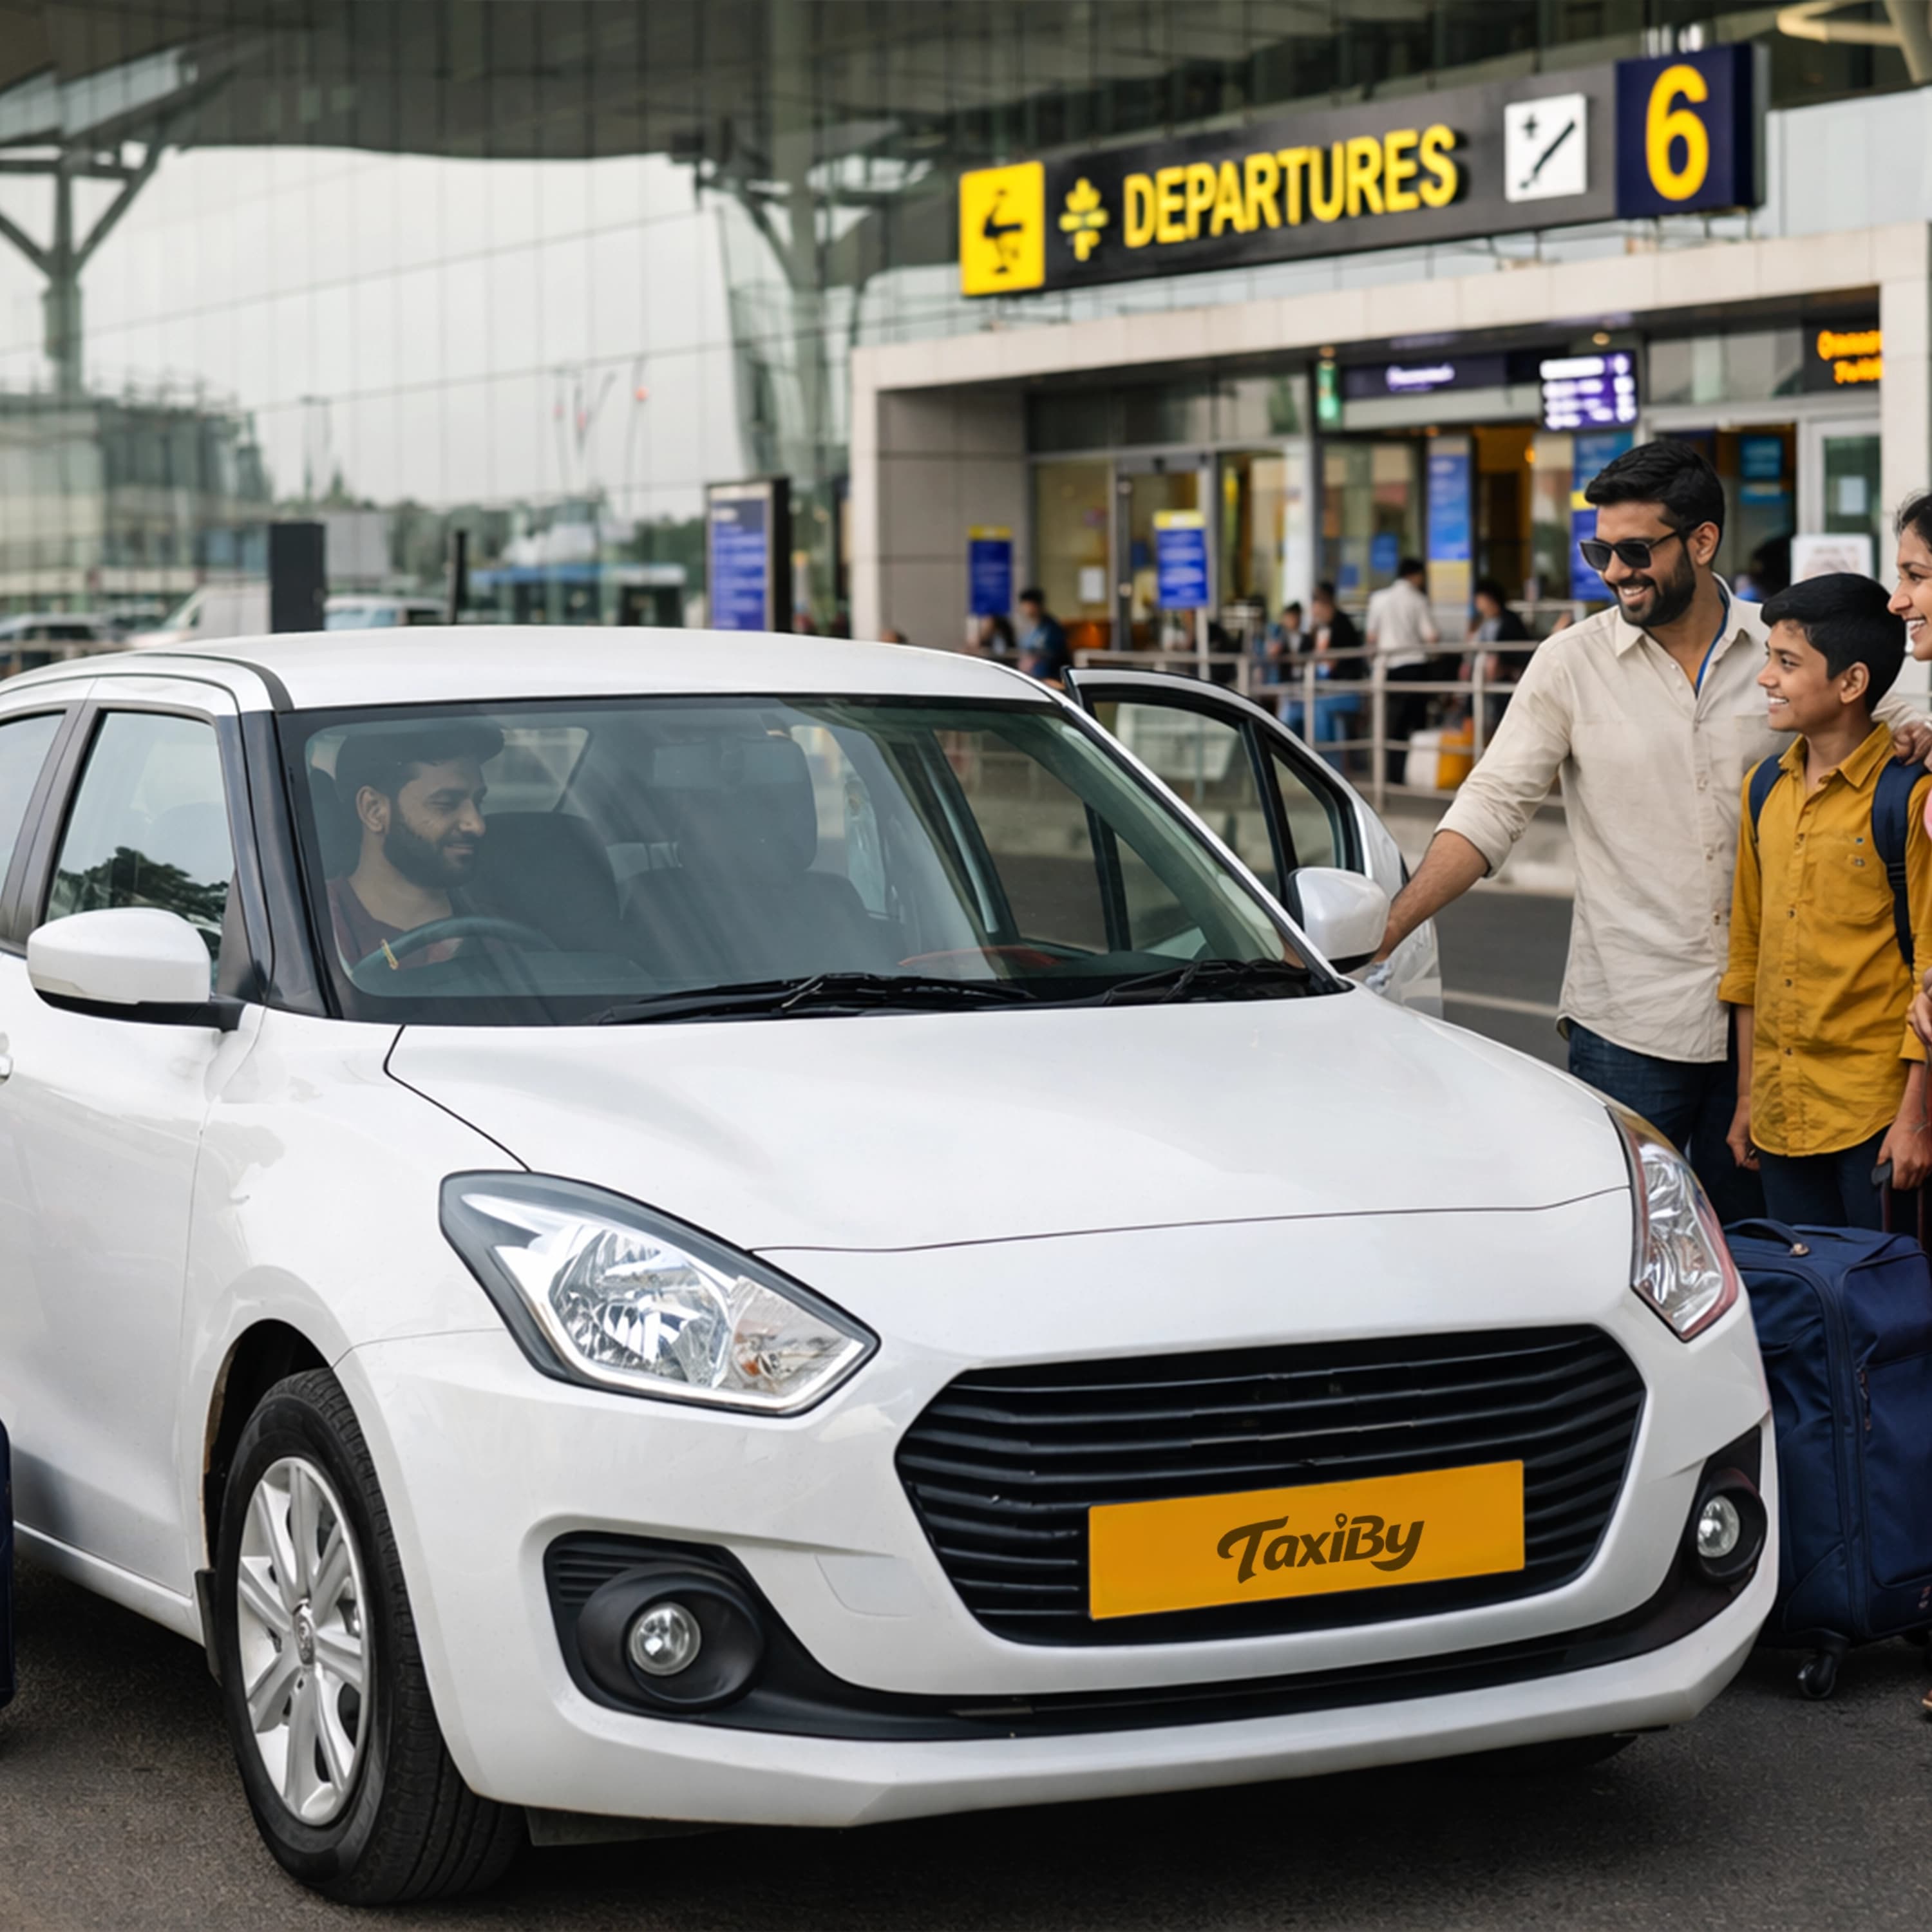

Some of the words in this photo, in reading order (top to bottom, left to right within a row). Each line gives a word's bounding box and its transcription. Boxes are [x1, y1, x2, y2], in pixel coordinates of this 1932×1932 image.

[1124, 124, 1457, 248] DEPARTURES
[1646, 65, 1709, 200] 6
[1217, 1513, 1424, 1583] TaxiBy
